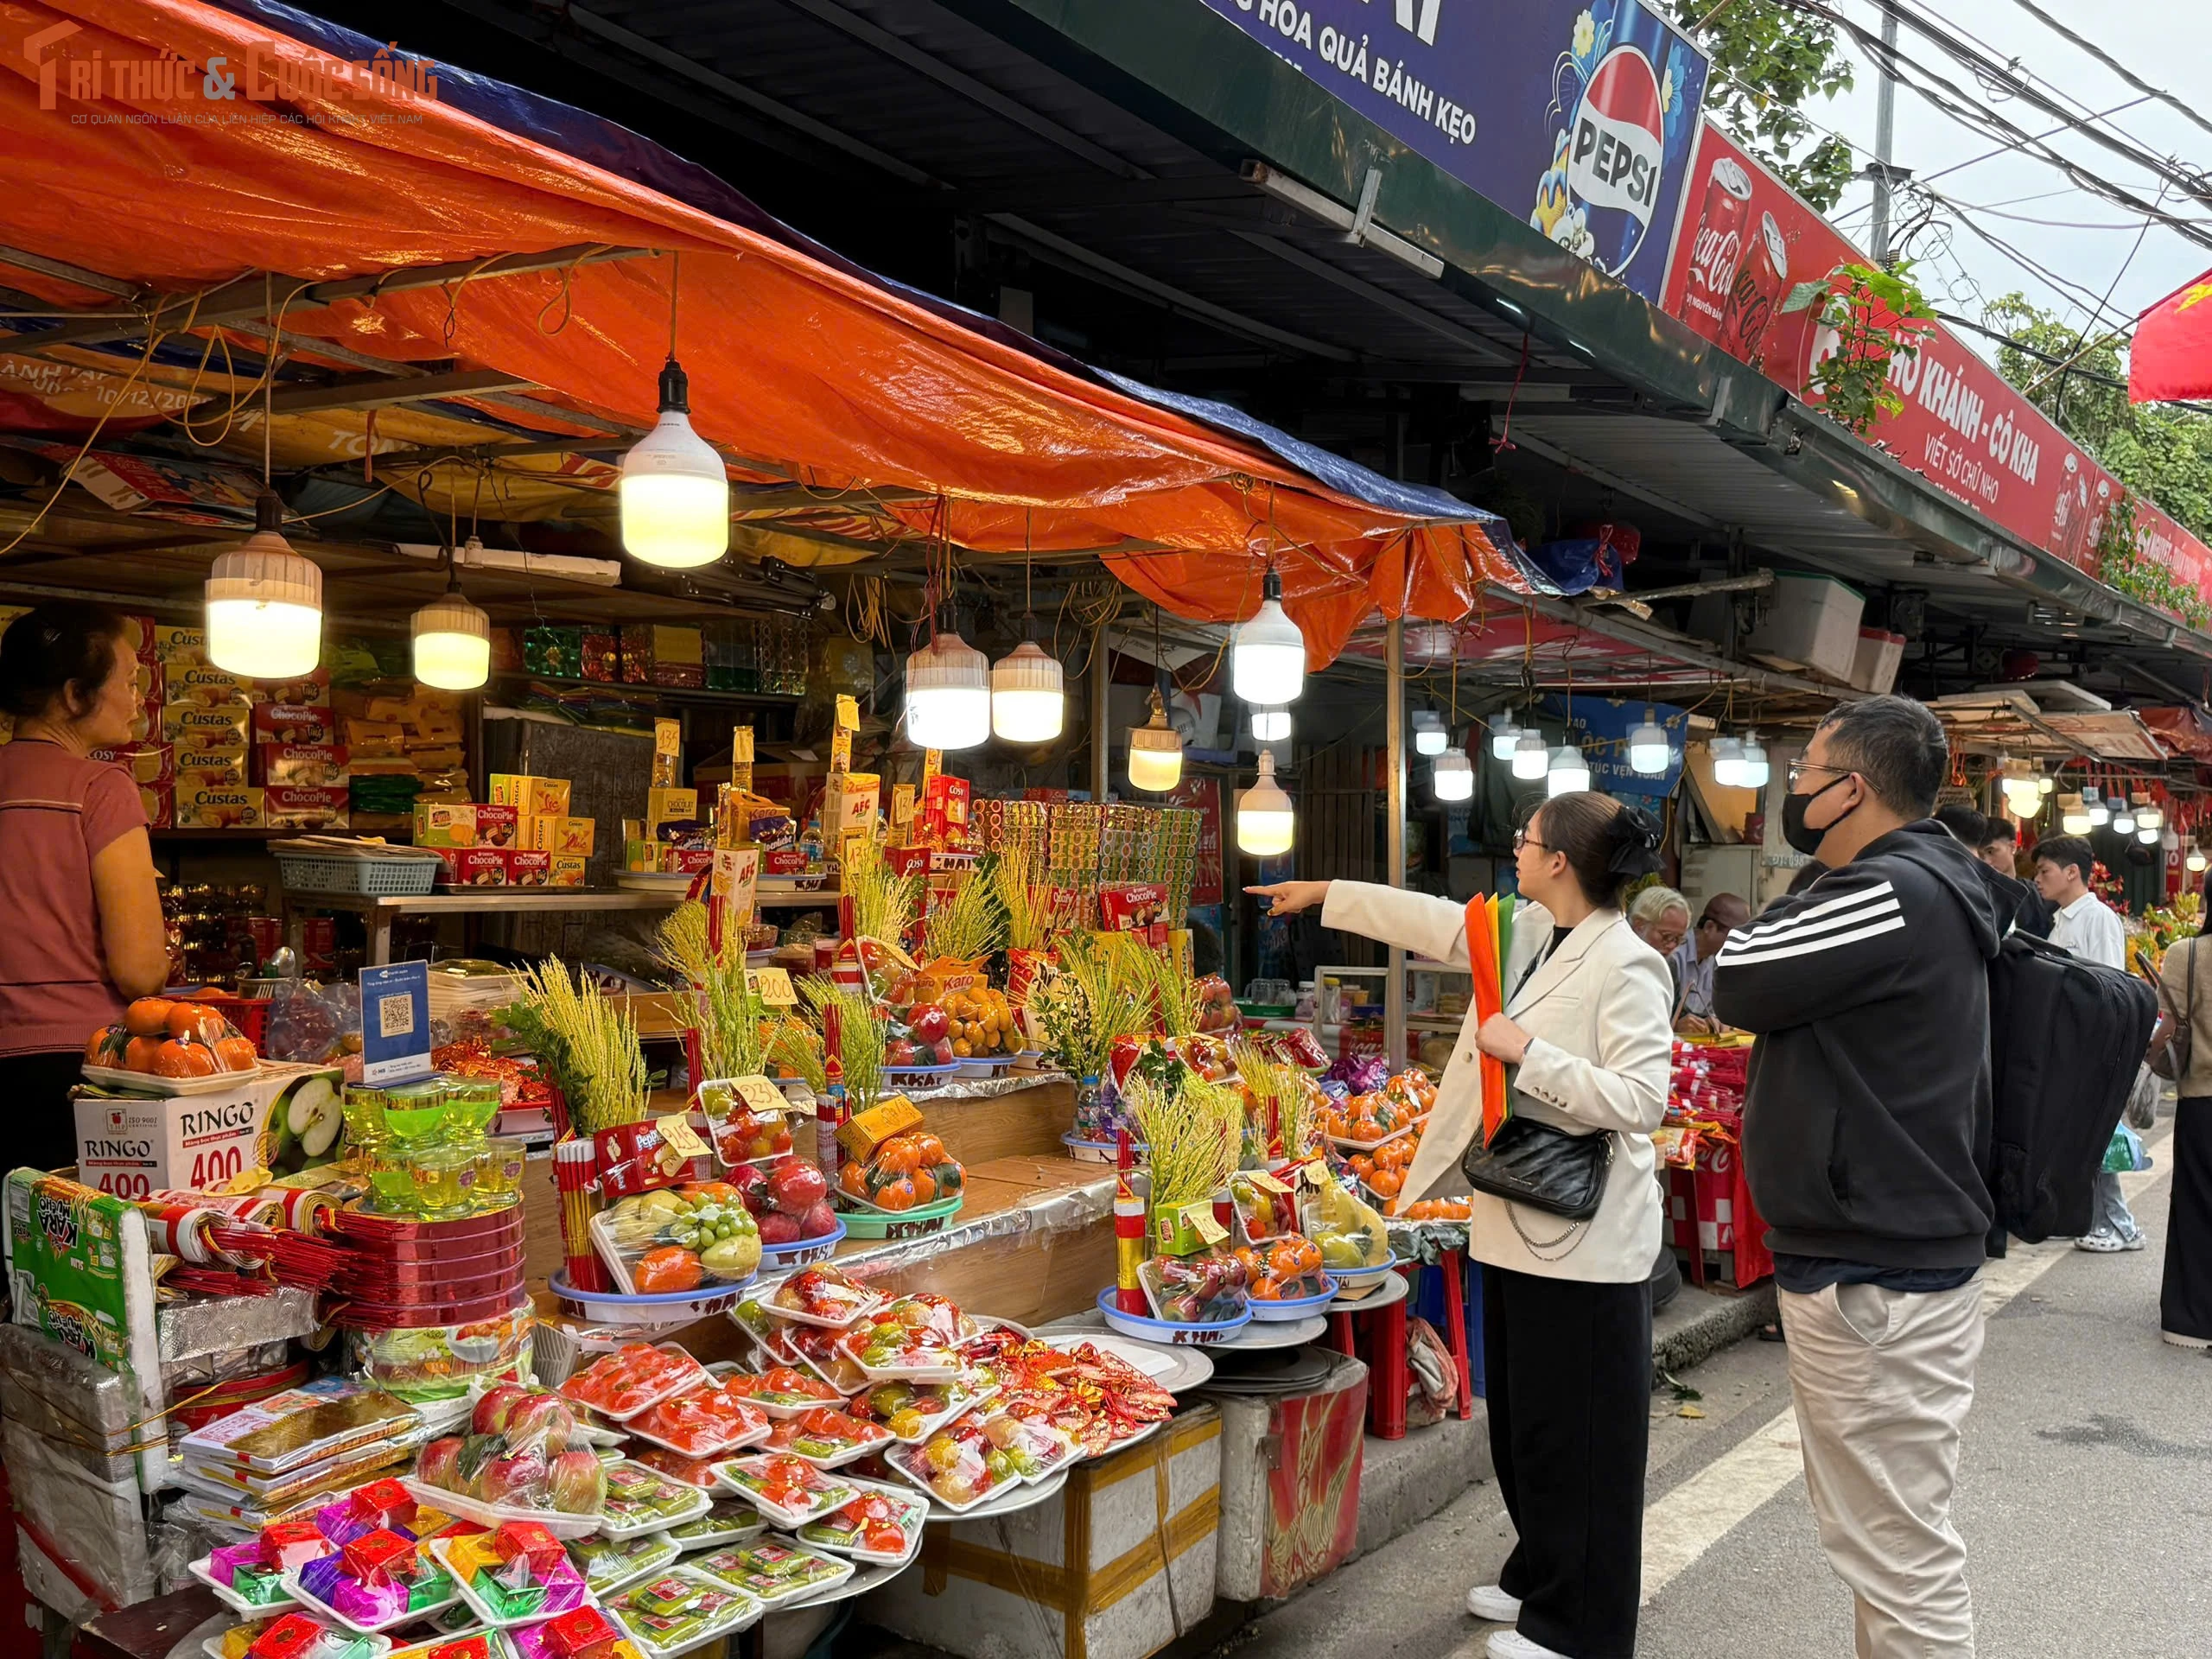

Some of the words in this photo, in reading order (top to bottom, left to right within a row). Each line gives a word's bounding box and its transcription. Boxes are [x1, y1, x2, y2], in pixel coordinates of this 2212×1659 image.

[1258, 0, 1312, 50] HOA
[1319, 26, 1368, 84] QUẢ
[1372, 57, 1433, 122] BÁNH
[1434, 96, 1477, 145] KẸO
[1573, 117, 1657, 207] PEPSI
[1917, 356, 1985, 443] KHÁNH
[1988, 410, 2015, 465] CÔ
[2008, 429, 2040, 486] KHA
[1924, 431, 1948, 471] VIẾT
[1946, 448, 1963, 479] SỚ
[1962, 461, 1982, 492] CHỮ
[1980, 471, 1999, 505] NHO
[170, 631, 206, 645] Cust
[184, 670, 236, 685] Custas
[181, 711, 232, 727] Custas
[270, 708, 318, 721] ChocoPie
[180, 753, 232, 767] Custas
[283, 747, 333, 760] ChocoPie
[194, 791, 248, 805] Custas
[282, 791, 332, 803] ChocoPie
[949, 785, 965, 796] COSY
[749, 808, 778, 821] Karo
[851, 798, 871, 816] AFC
[477, 810, 514, 820] ChocoPie
[467, 855, 504, 865] ChocoPie
[514, 855, 548, 866] ChocoPie
[556, 860, 582, 870] Custas
[738, 862, 755, 885] AFC
[1126, 889, 1157, 904] ChocoPie
[760, 975, 794, 999] 200
[943, 975, 975, 993] Karo
[180, 1101, 255, 1138] RINGO
[84, 1140, 151, 1158] RINGO
[190, 1146, 242, 1192] 400
[98, 1172, 150, 1200] 400
